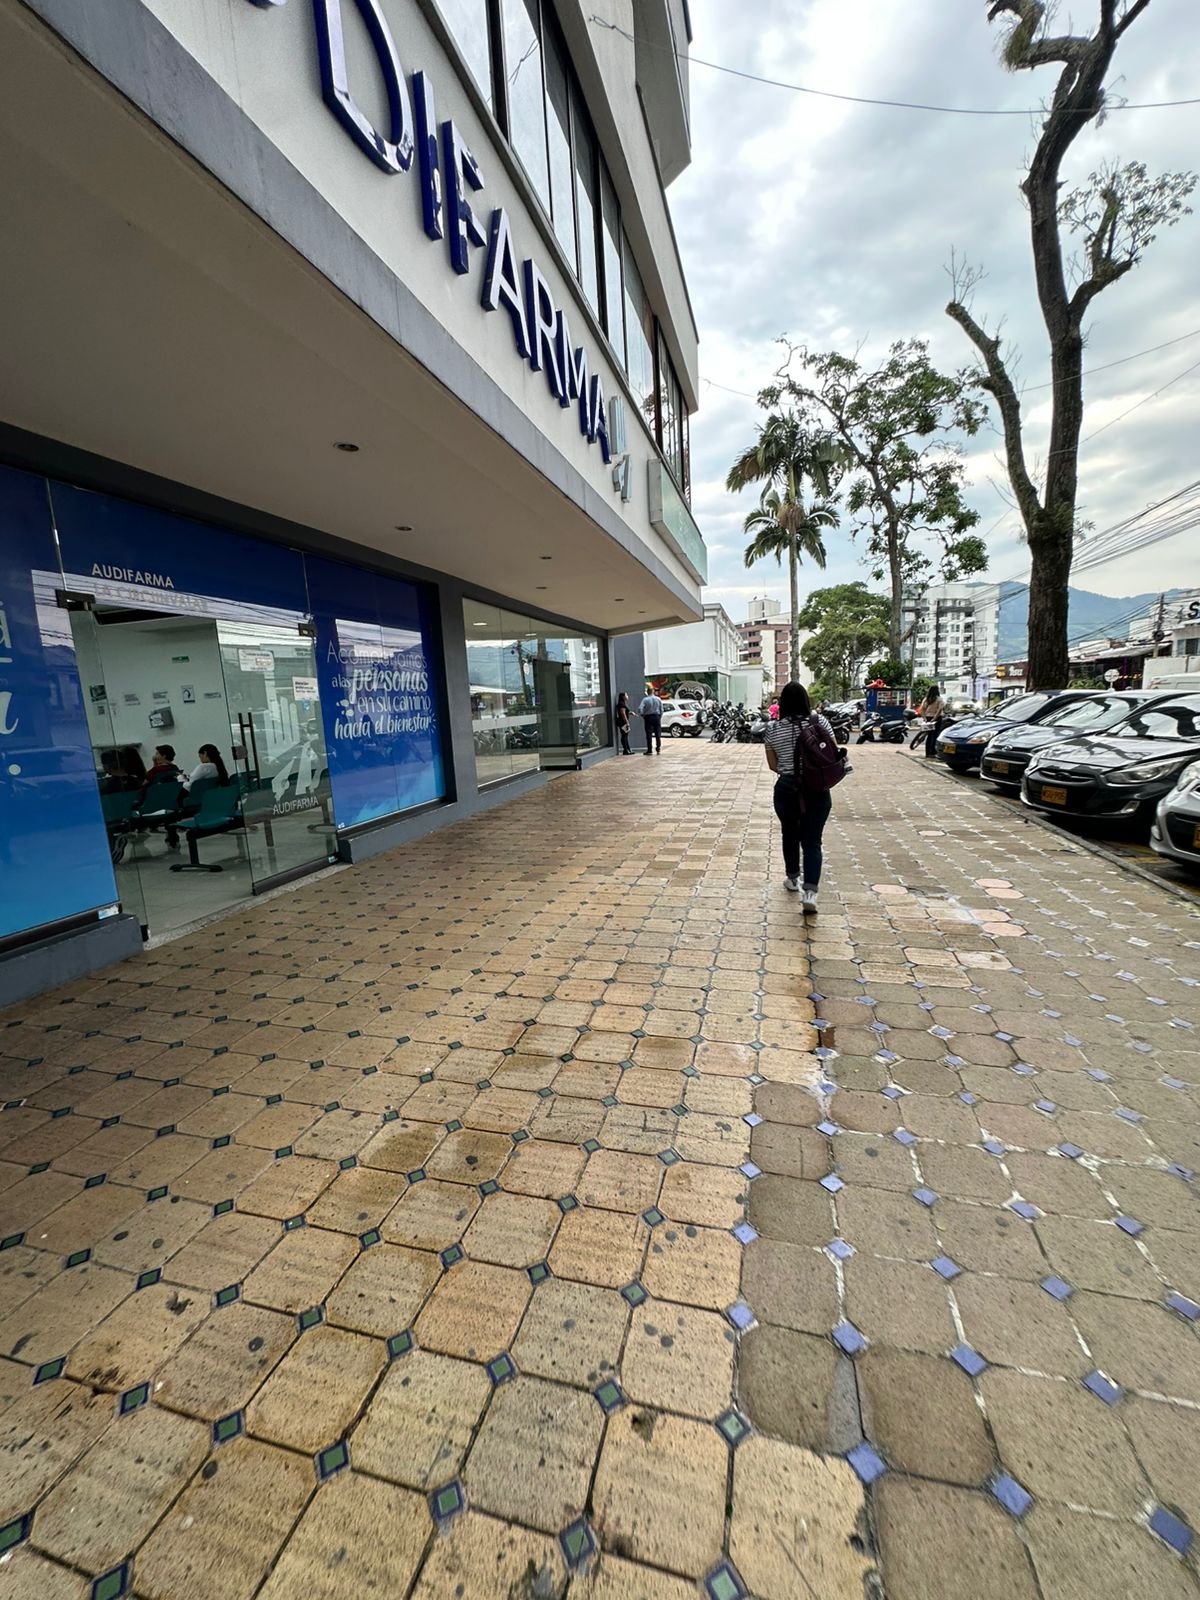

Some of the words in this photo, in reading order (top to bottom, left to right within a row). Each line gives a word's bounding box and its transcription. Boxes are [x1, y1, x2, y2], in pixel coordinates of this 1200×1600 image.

[247, 0, 612, 465] DIFARMA
[91, 563, 175, 589] AUDIFARMA
[348, 668, 428, 704] personas
[357, 696, 375, 714] en
[377, 694, 391, 713] su
[392, 693, 431, 712] camino
[374, 714, 385, 735] el
[387, 712, 432, 735] bienestar
[273, 796, 319, 815] AUDIFARMA
